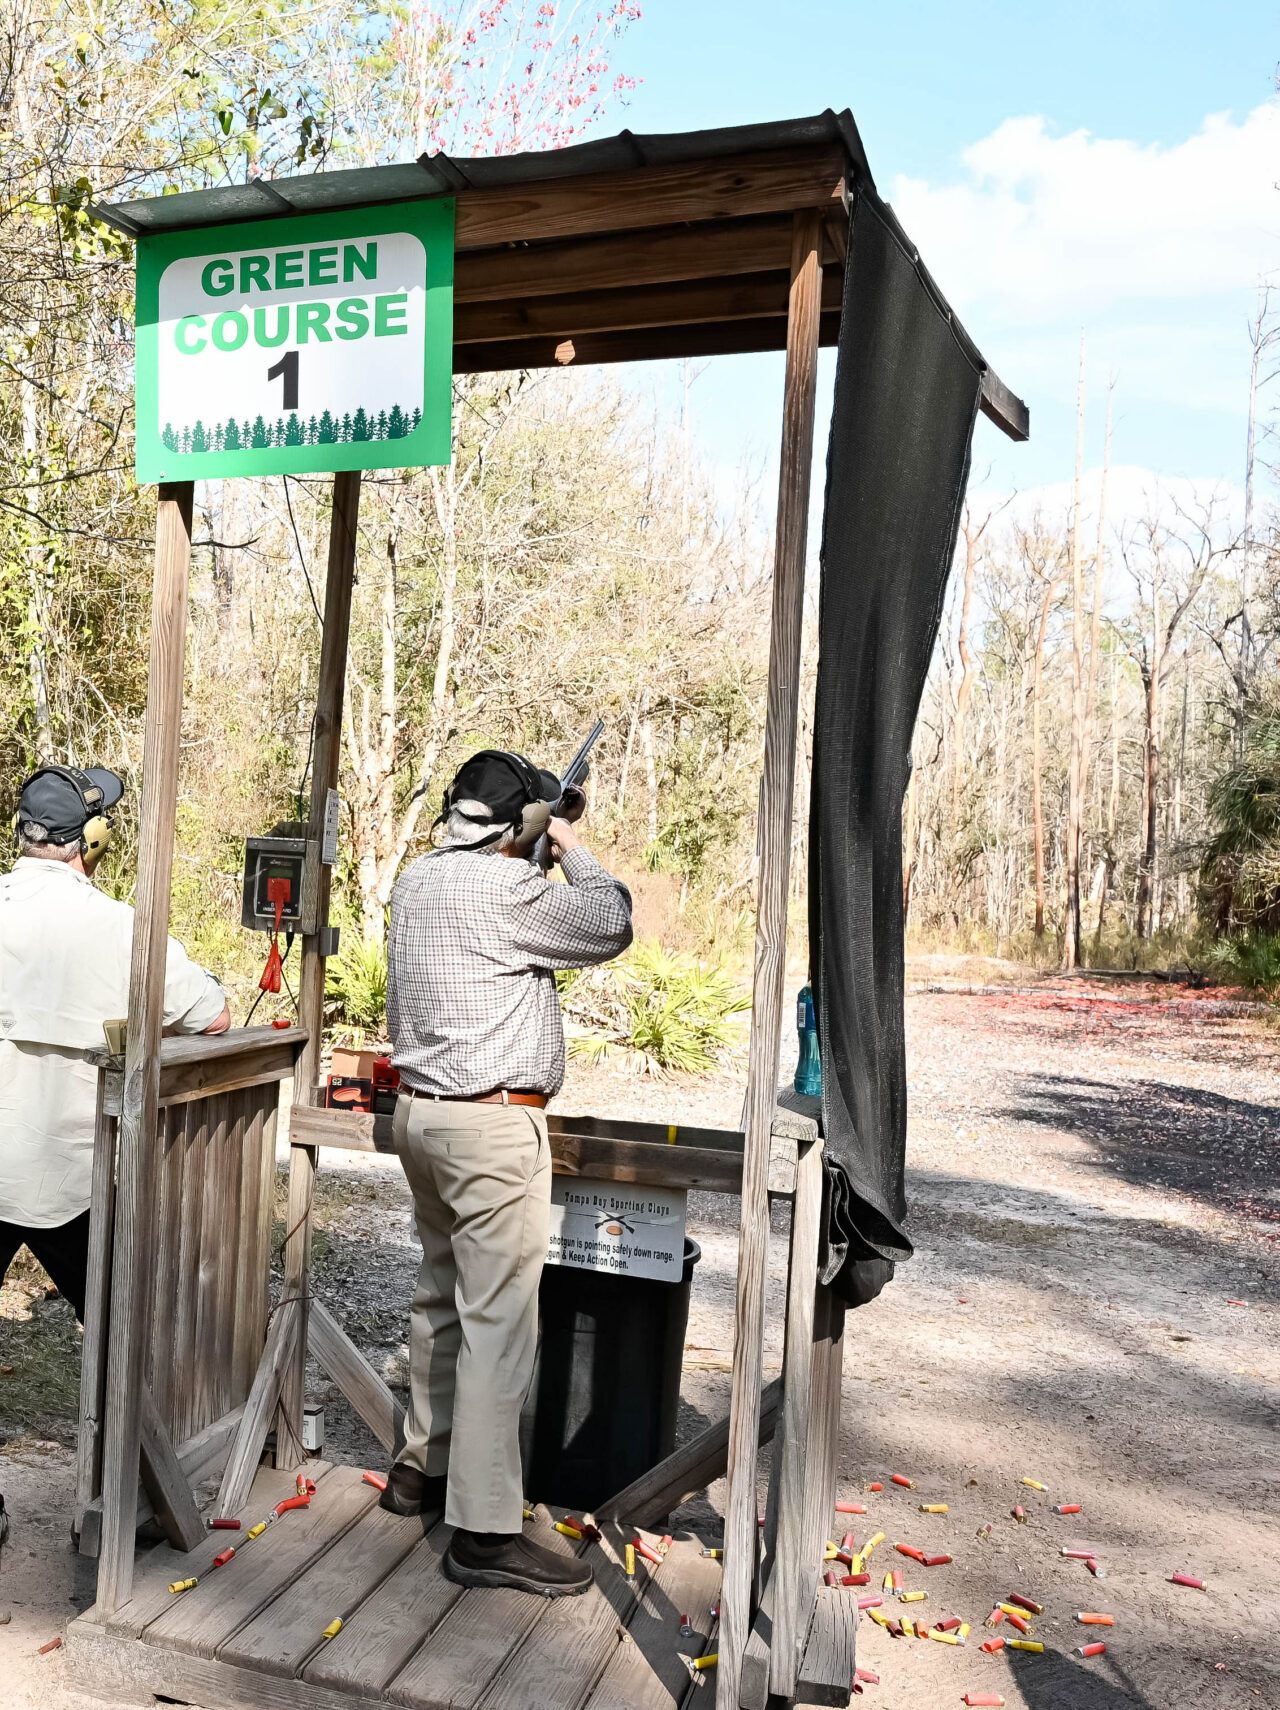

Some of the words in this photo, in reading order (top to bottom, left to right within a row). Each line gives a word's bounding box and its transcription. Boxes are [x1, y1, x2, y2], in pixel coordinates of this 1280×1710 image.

[201, 242, 378, 297] GREEN
[174, 293, 408, 355] COURSE
[267, 350, 299, 410] 1
[565, 1192, 589, 1206] Tampa
[593, 1195, 607, 1208] Bay
[610, 1198, 645, 1213] Sporting
[648, 1202, 670, 1216] Clays
[549, 1233, 575, 1248] shotgun
[576, 1237, 583, 1248] is
[584, 1240, 611, 1255] pointing
[612, 1243, 632, 1258] safely
[633, 1245, 652, 1259] down
[653, 1251, 675, 1264] range.
[561, 1249, 567, 1260] &
[568, 1250, 586, 1265] Keep
[586, 1253, 608, 1266] Action
[609, 1256, 629, 1270] Open.
